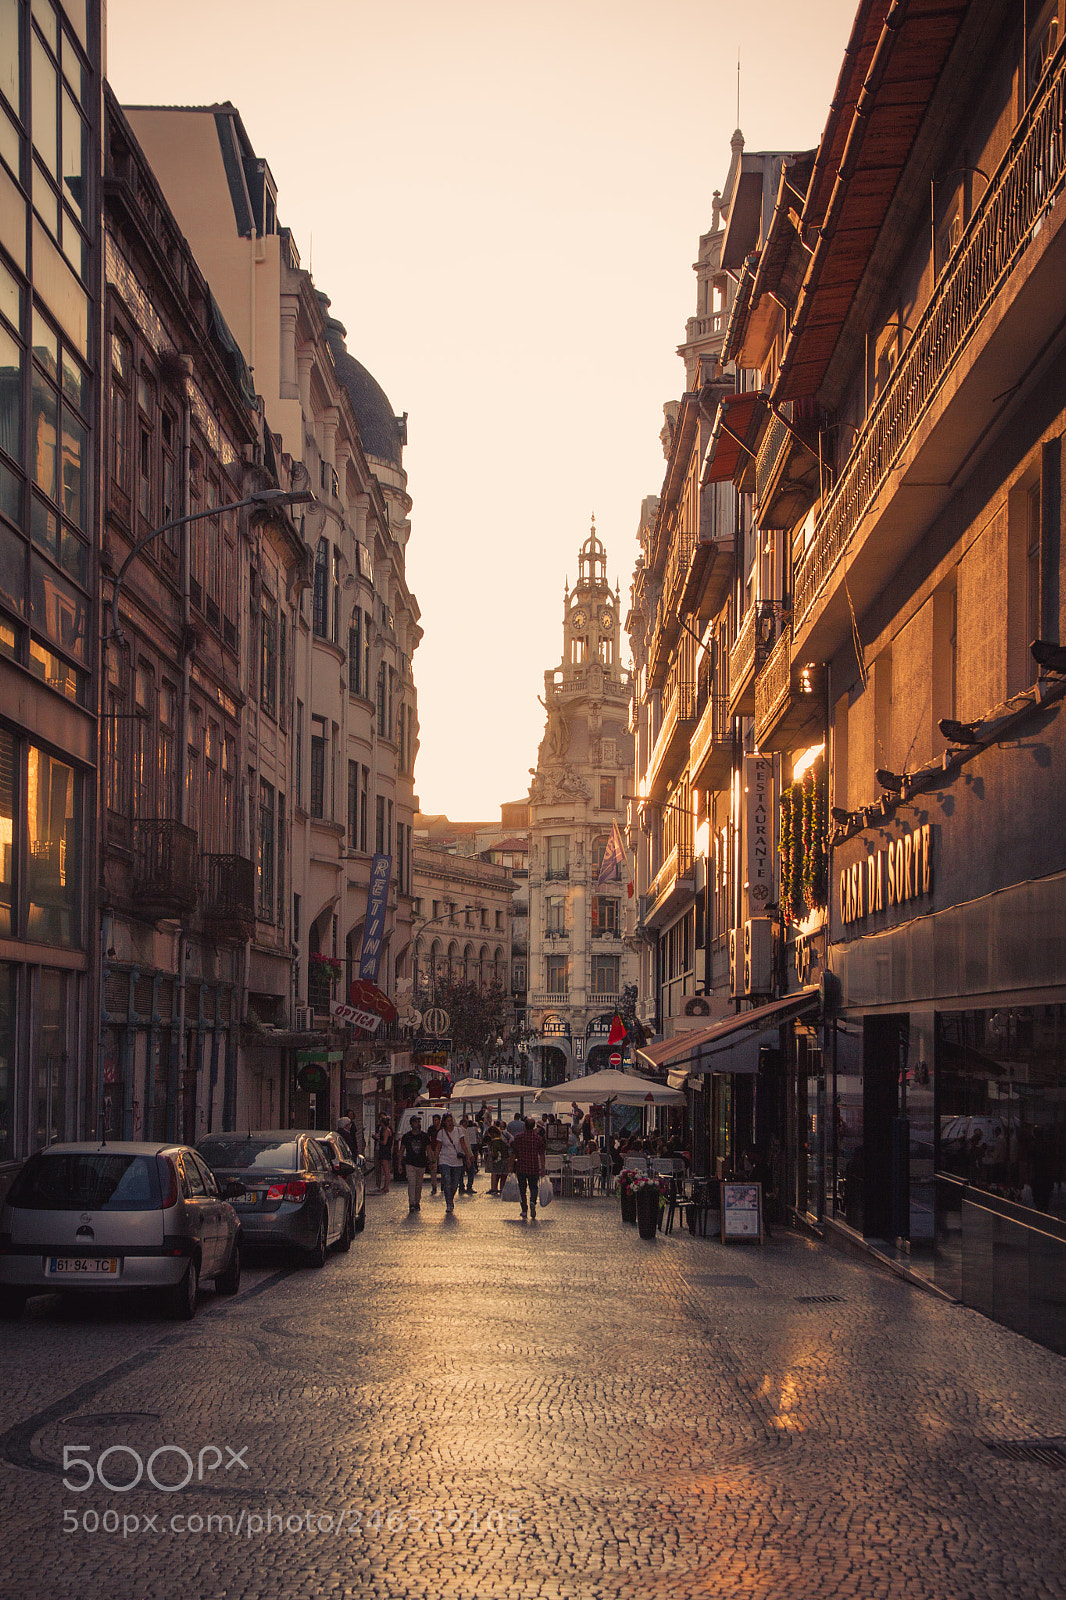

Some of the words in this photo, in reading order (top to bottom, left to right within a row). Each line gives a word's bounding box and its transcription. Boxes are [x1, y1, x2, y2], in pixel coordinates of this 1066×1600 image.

[755, 761, 767, 878] RESTAURANTE
[840, 861, 863, 925] CASA
[867, 850, 882, 914] DA
[888, 824, 930, 906] SORTE
[362, 858, 389, 975] RETINA
